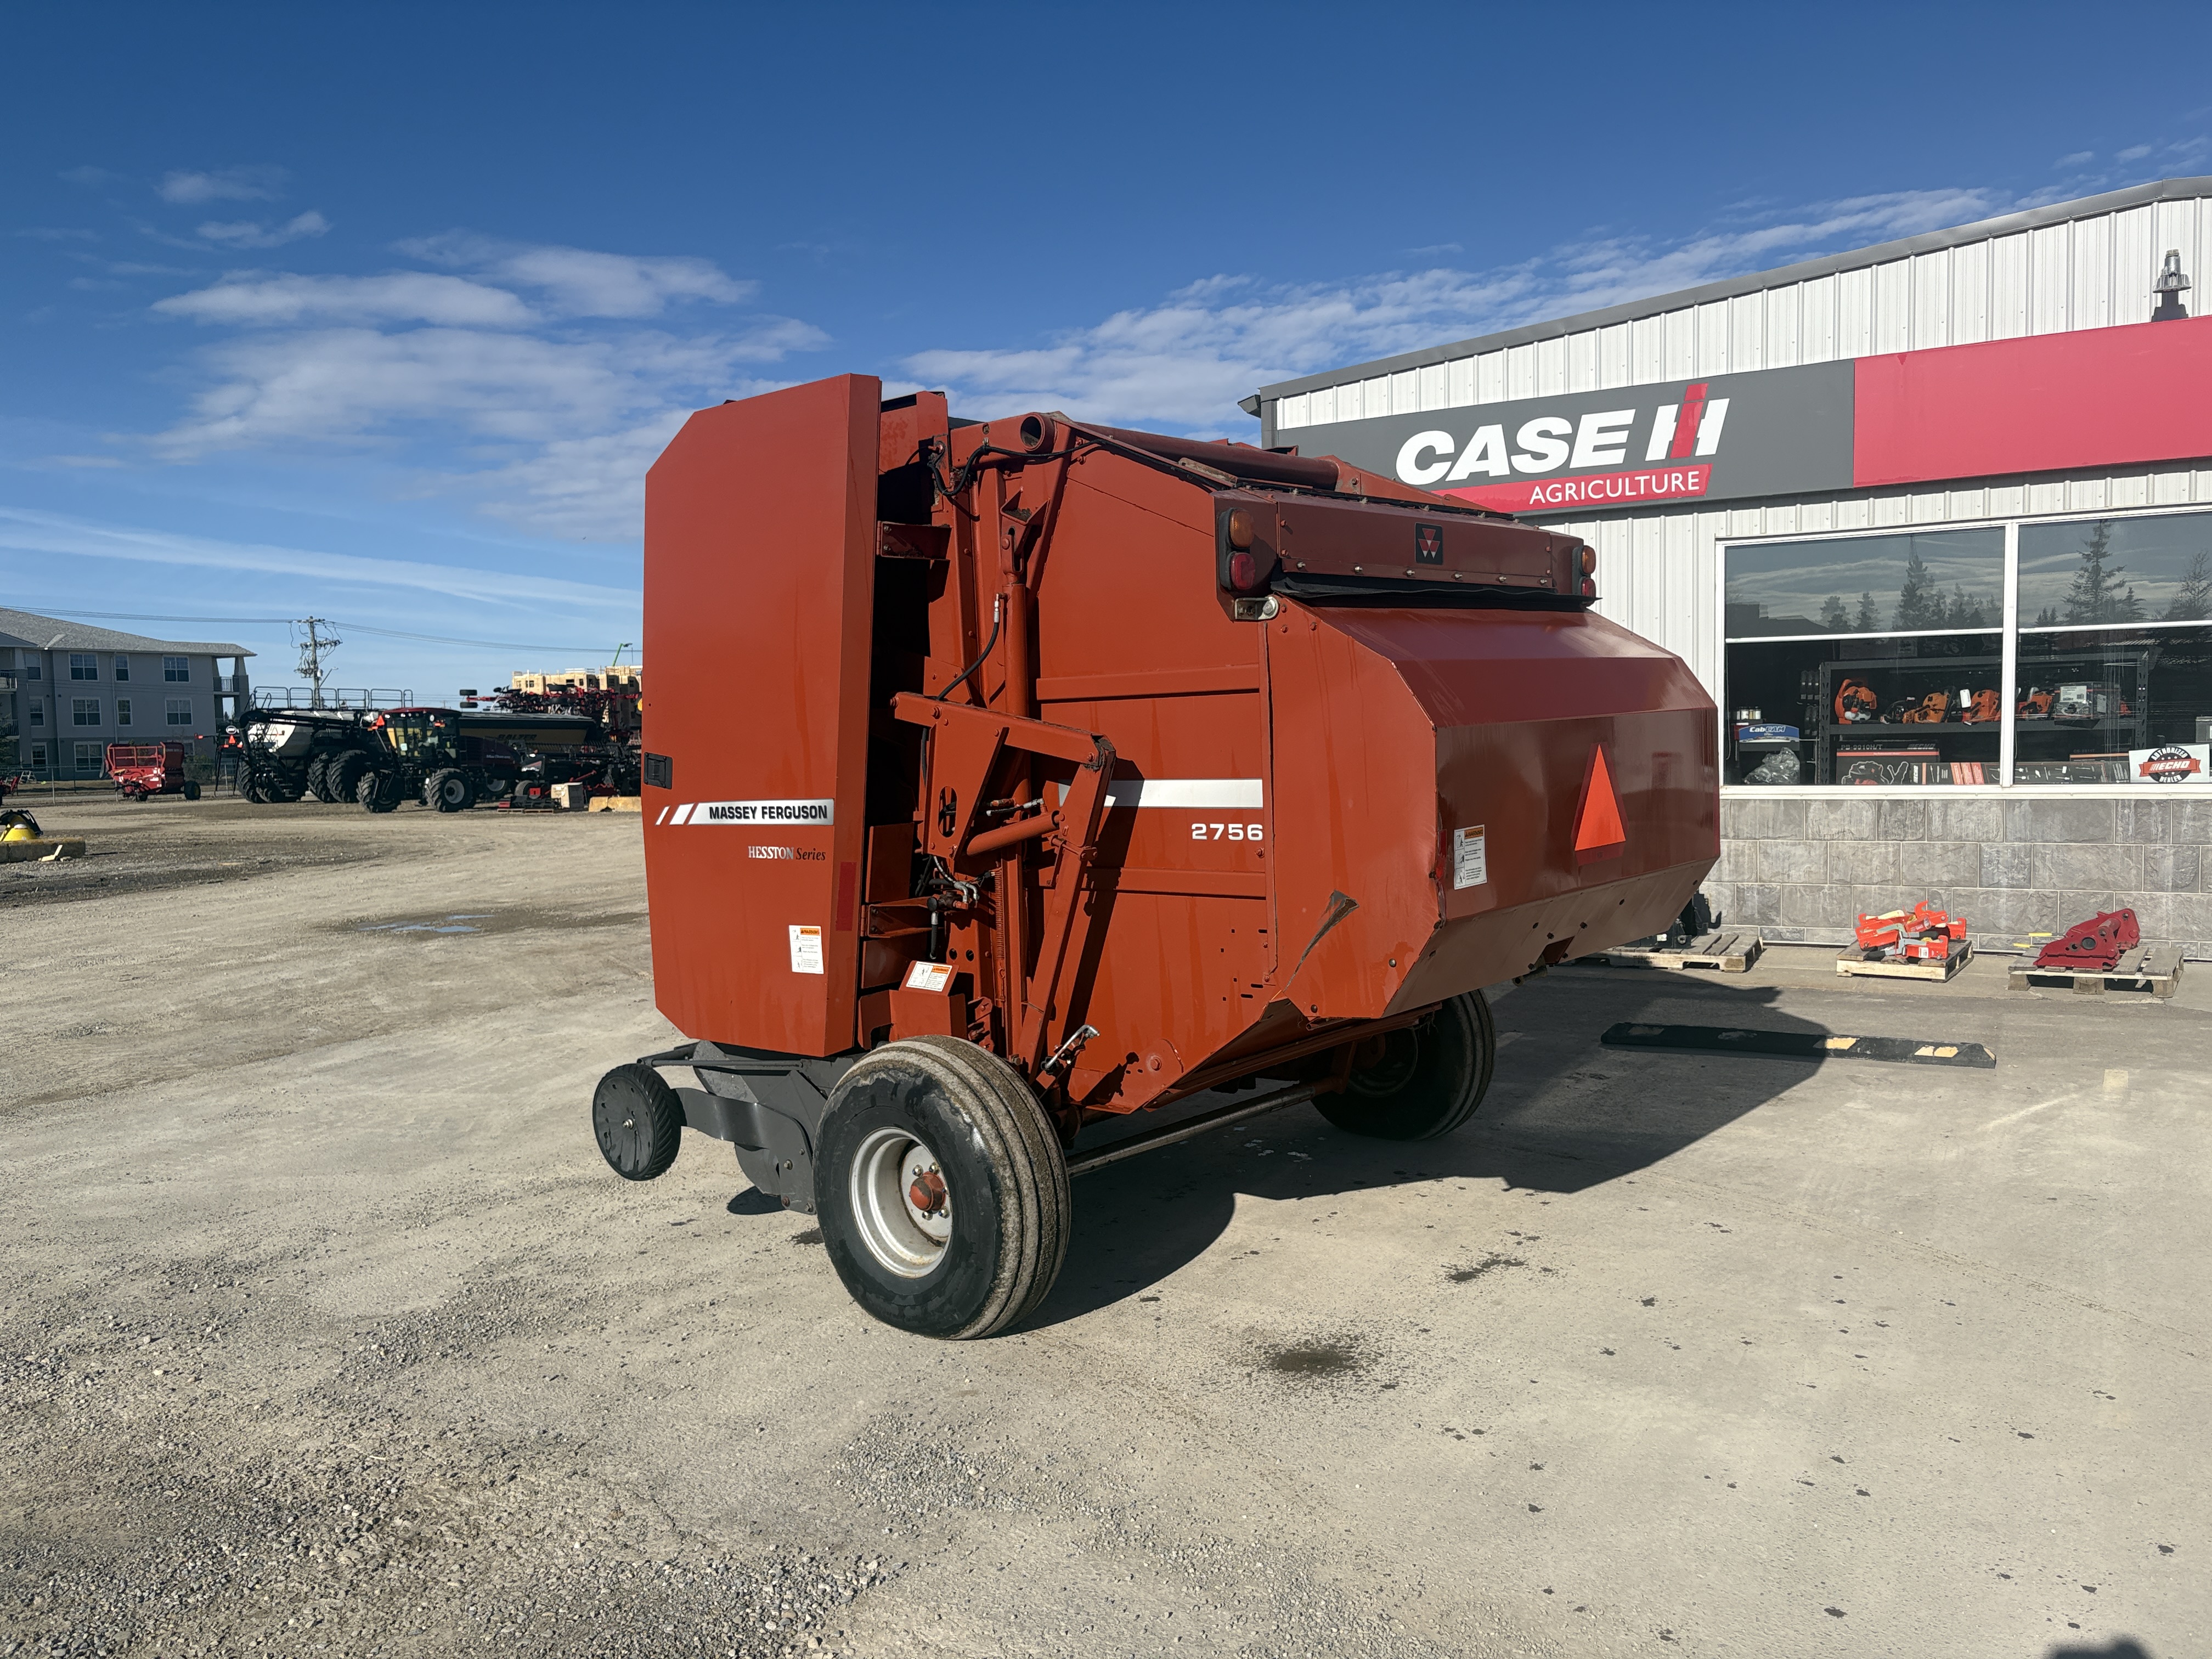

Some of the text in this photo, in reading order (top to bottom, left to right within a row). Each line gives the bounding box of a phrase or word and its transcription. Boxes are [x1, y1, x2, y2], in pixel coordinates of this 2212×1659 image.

[1396, 408, 1636, 486] CASE
[1529, 471, 1700, 505] AGRICULTURE
[2151, 747, 2188, 760] AUTHORIZED
[2149, 760, 2191, 771] ECHO
[2159, 774, 2182, 783] DEALER
[709, 805, 827, 820] MASSEY FERGUSON
[1192, 823, 1263, 840] 2756
[748, 845, 826, 861] HESSTON Series
